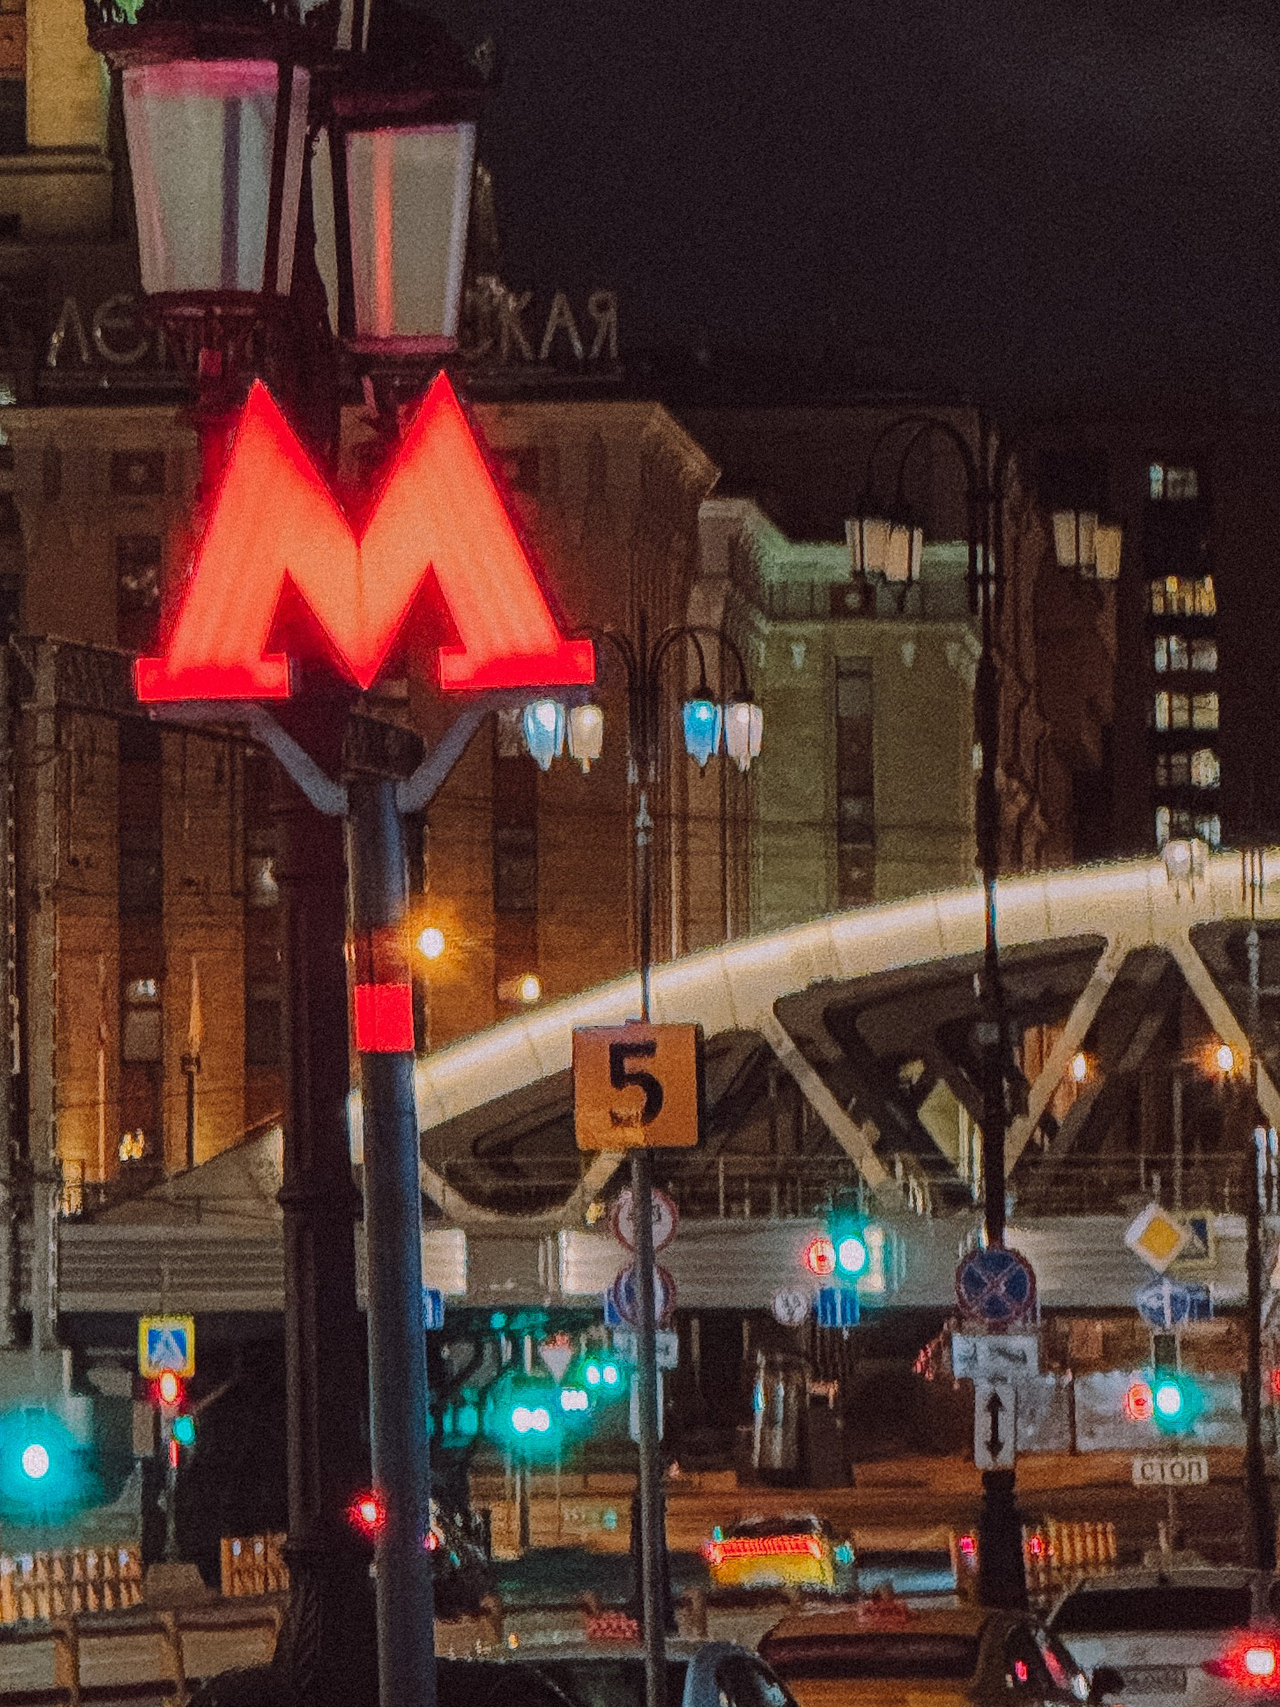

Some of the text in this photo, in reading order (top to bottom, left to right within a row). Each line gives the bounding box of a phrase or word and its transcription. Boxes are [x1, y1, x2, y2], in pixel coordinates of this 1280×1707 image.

[135, 368, 596, 701] М
[608, 1040, 664, 1127] 5
[1140, 1461, 1202, 1482] СТОП
